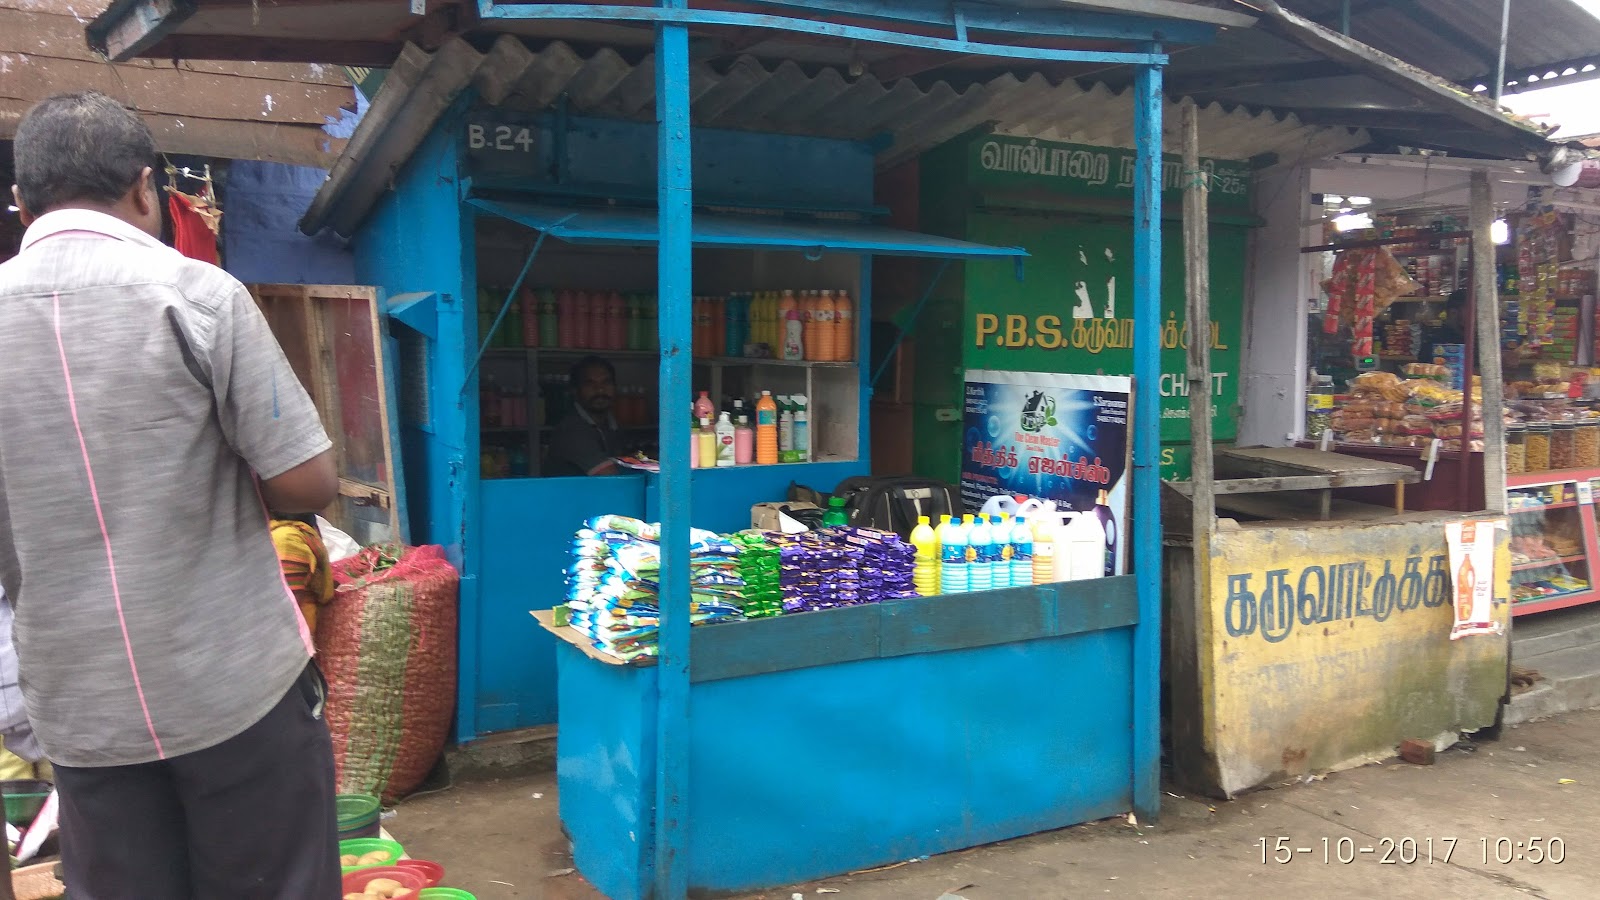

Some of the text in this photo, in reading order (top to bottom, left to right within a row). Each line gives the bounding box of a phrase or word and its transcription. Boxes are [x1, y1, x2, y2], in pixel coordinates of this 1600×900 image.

[468, 124, 534, 152] B.24
[981, 139, 1109, 186] வால்பாறை
[976, 313, 1068, 348] P.B.S.
